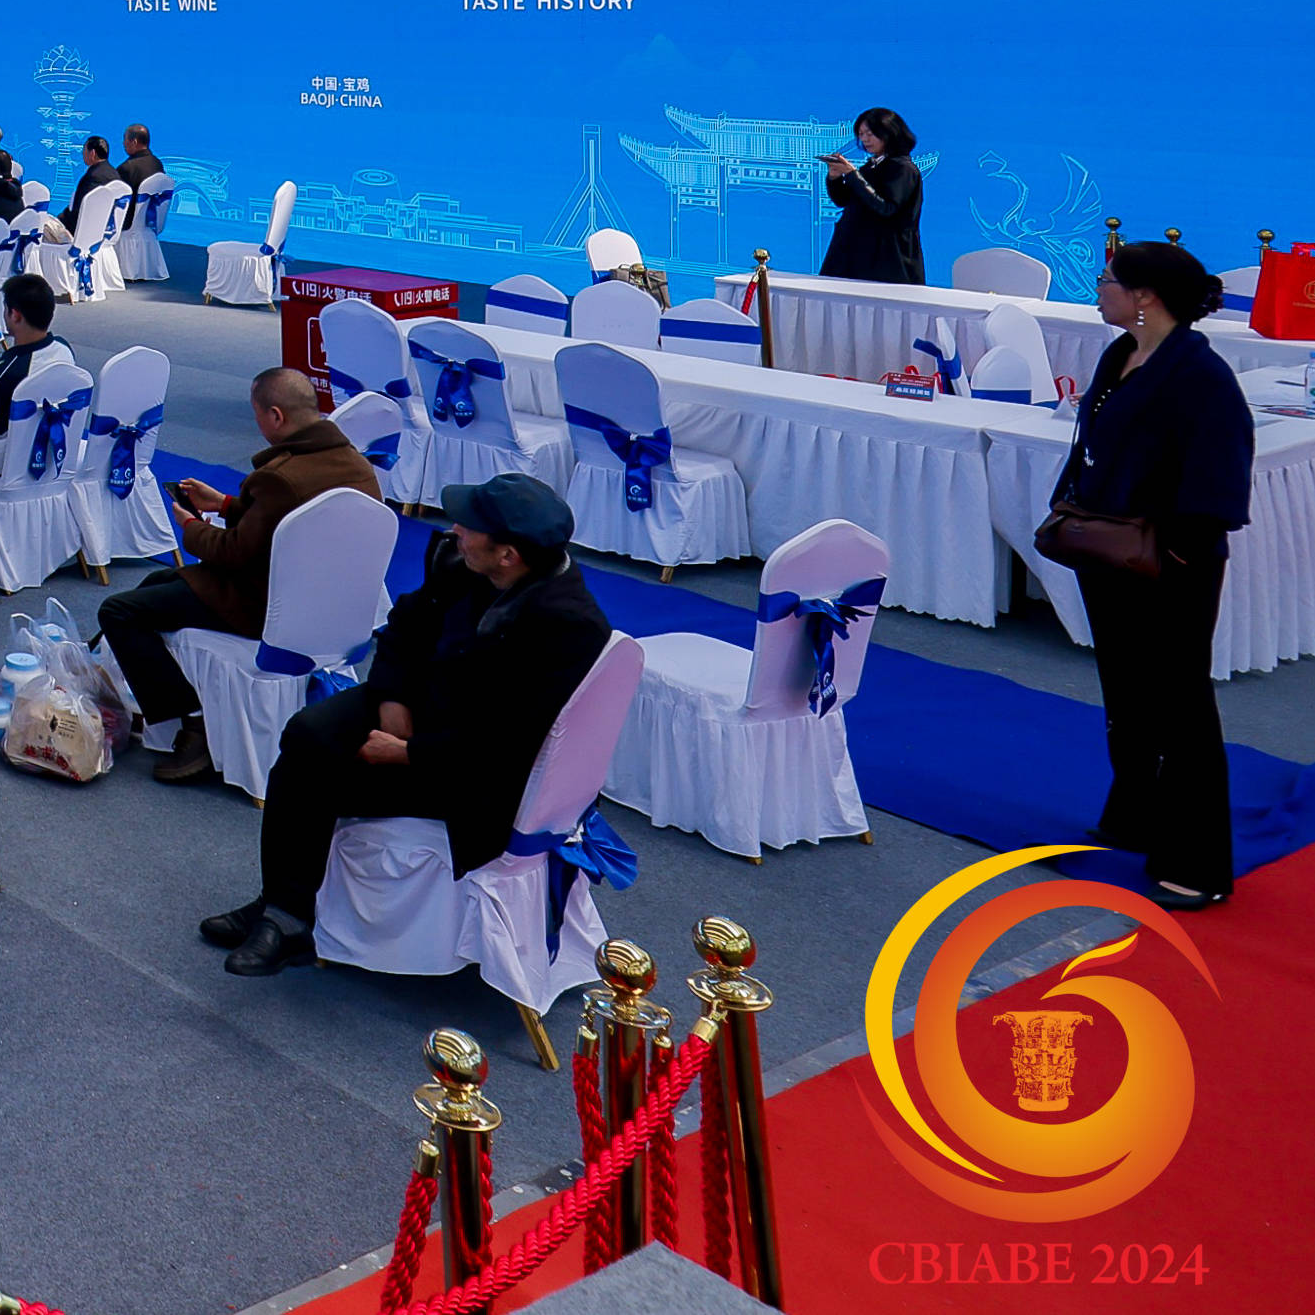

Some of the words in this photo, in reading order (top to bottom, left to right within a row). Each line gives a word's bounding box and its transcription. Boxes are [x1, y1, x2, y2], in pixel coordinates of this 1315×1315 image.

[311, 76, 370, 93] 中国·宝鸡
[415, 287, 450, 304] 火警电话
